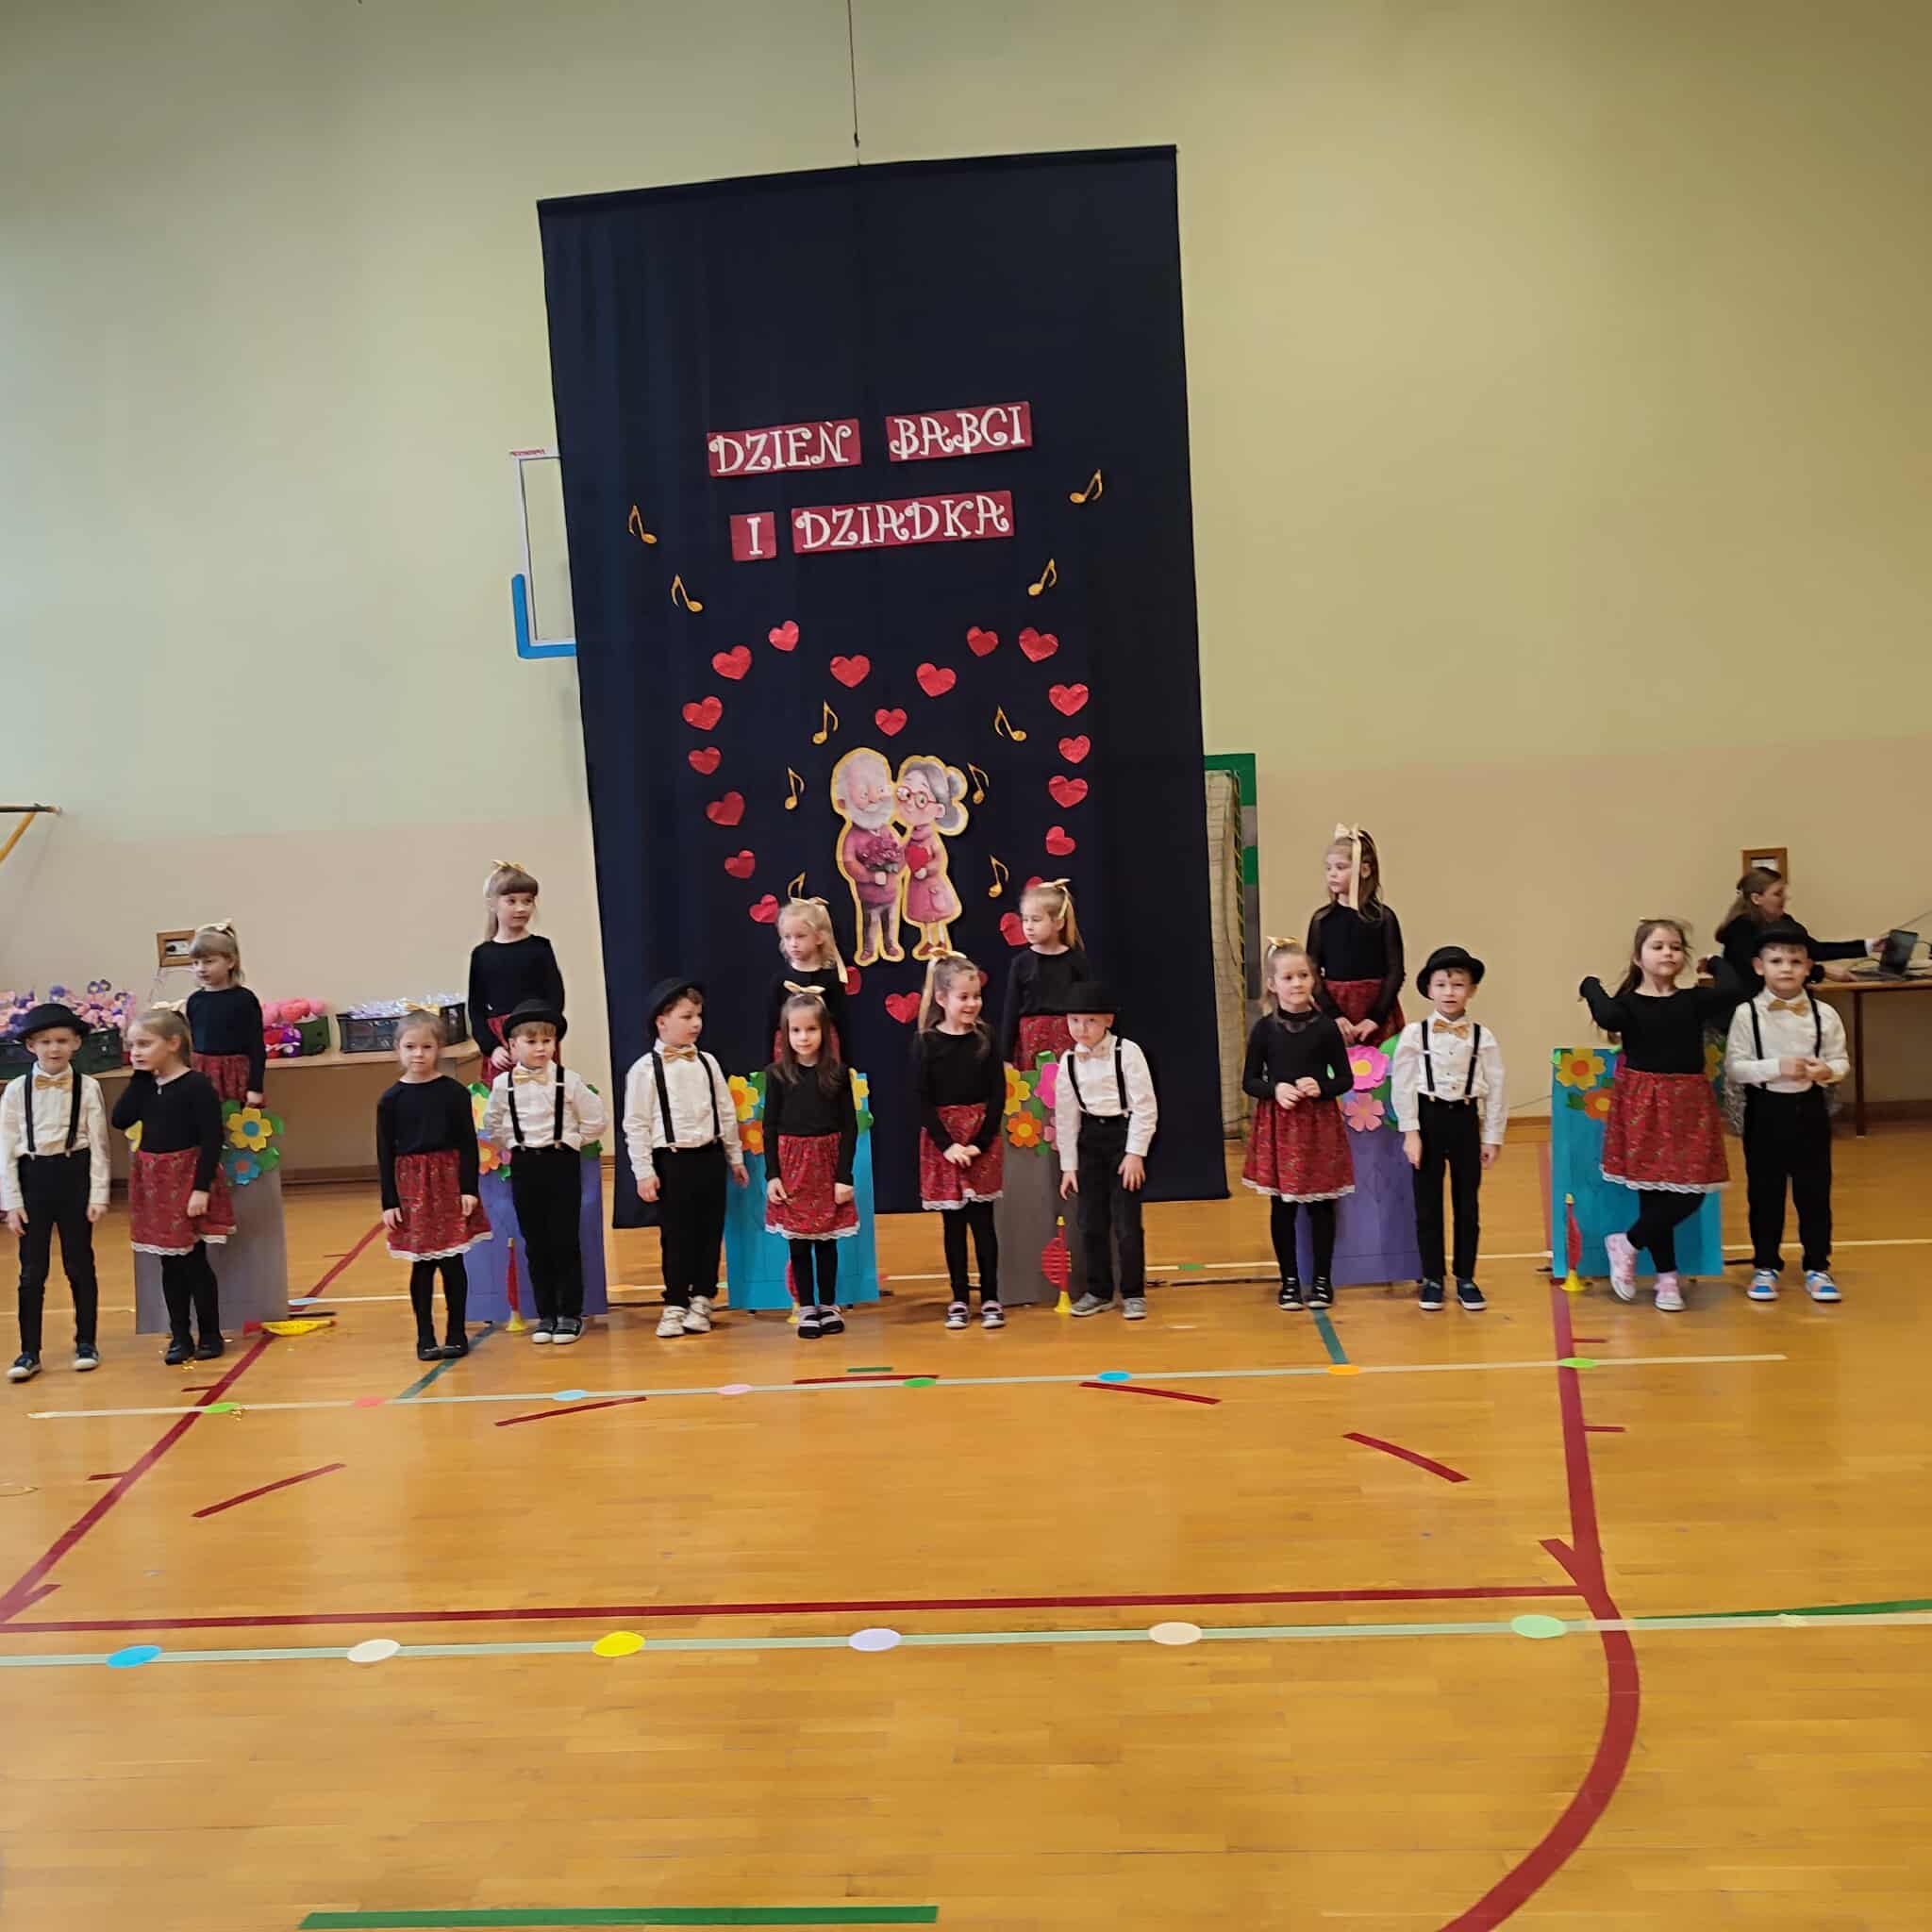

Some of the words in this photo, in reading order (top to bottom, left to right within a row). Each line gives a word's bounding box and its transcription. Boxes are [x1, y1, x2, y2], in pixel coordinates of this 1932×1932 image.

[890, 406, 1024, 459] BABCI
[746, 517, 763, 556] I
[795, 495, 1010, 550] DZIADKA
